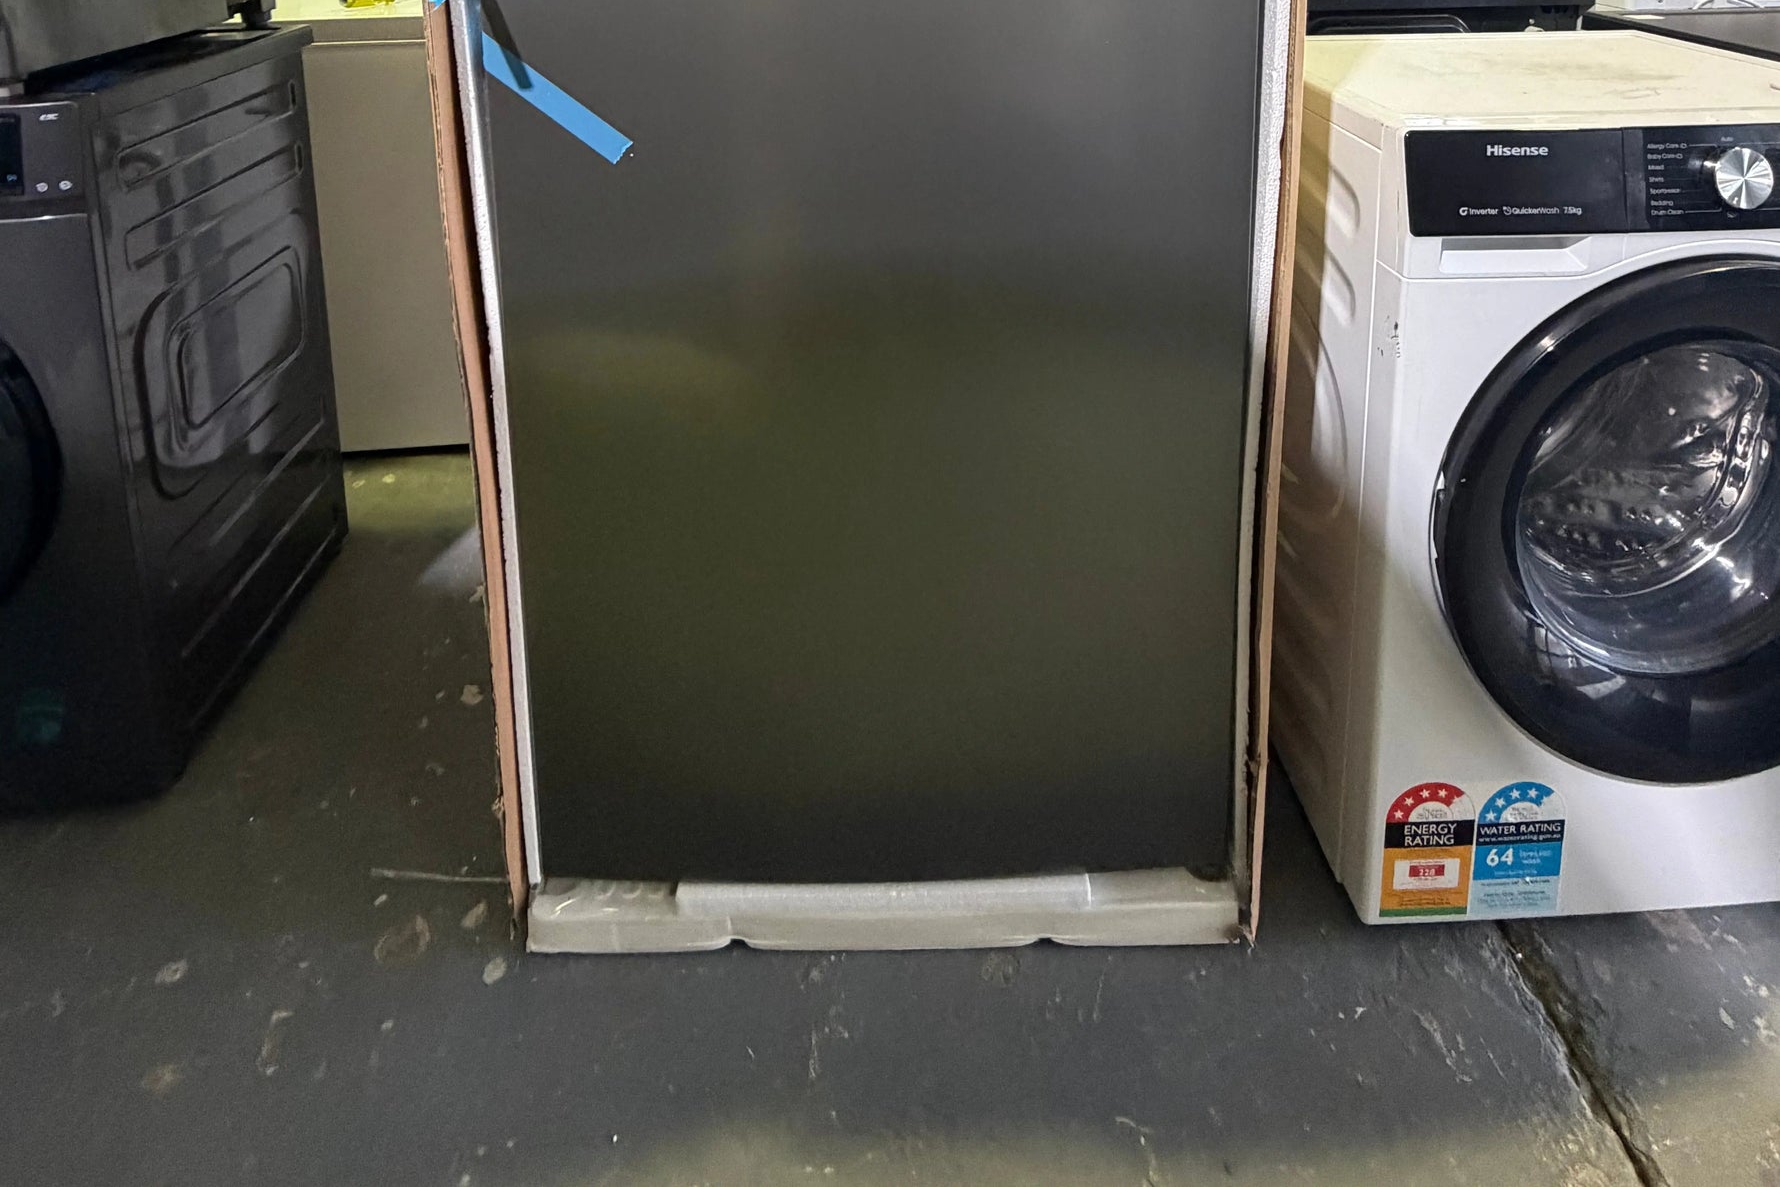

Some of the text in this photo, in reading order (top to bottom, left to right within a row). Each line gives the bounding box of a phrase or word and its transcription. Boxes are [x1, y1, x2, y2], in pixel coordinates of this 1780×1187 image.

[1486, 145, 1548, 156] Hisense
[1513, 206, 1560, 214] QuickerWash
[1404, 823, 1457, 835] ENERGY
[1480, 823, 1561, 835] WATER RATING
[1404, 835, 1454, 846] RATING
[1486, 847, 1514, 866] 64
